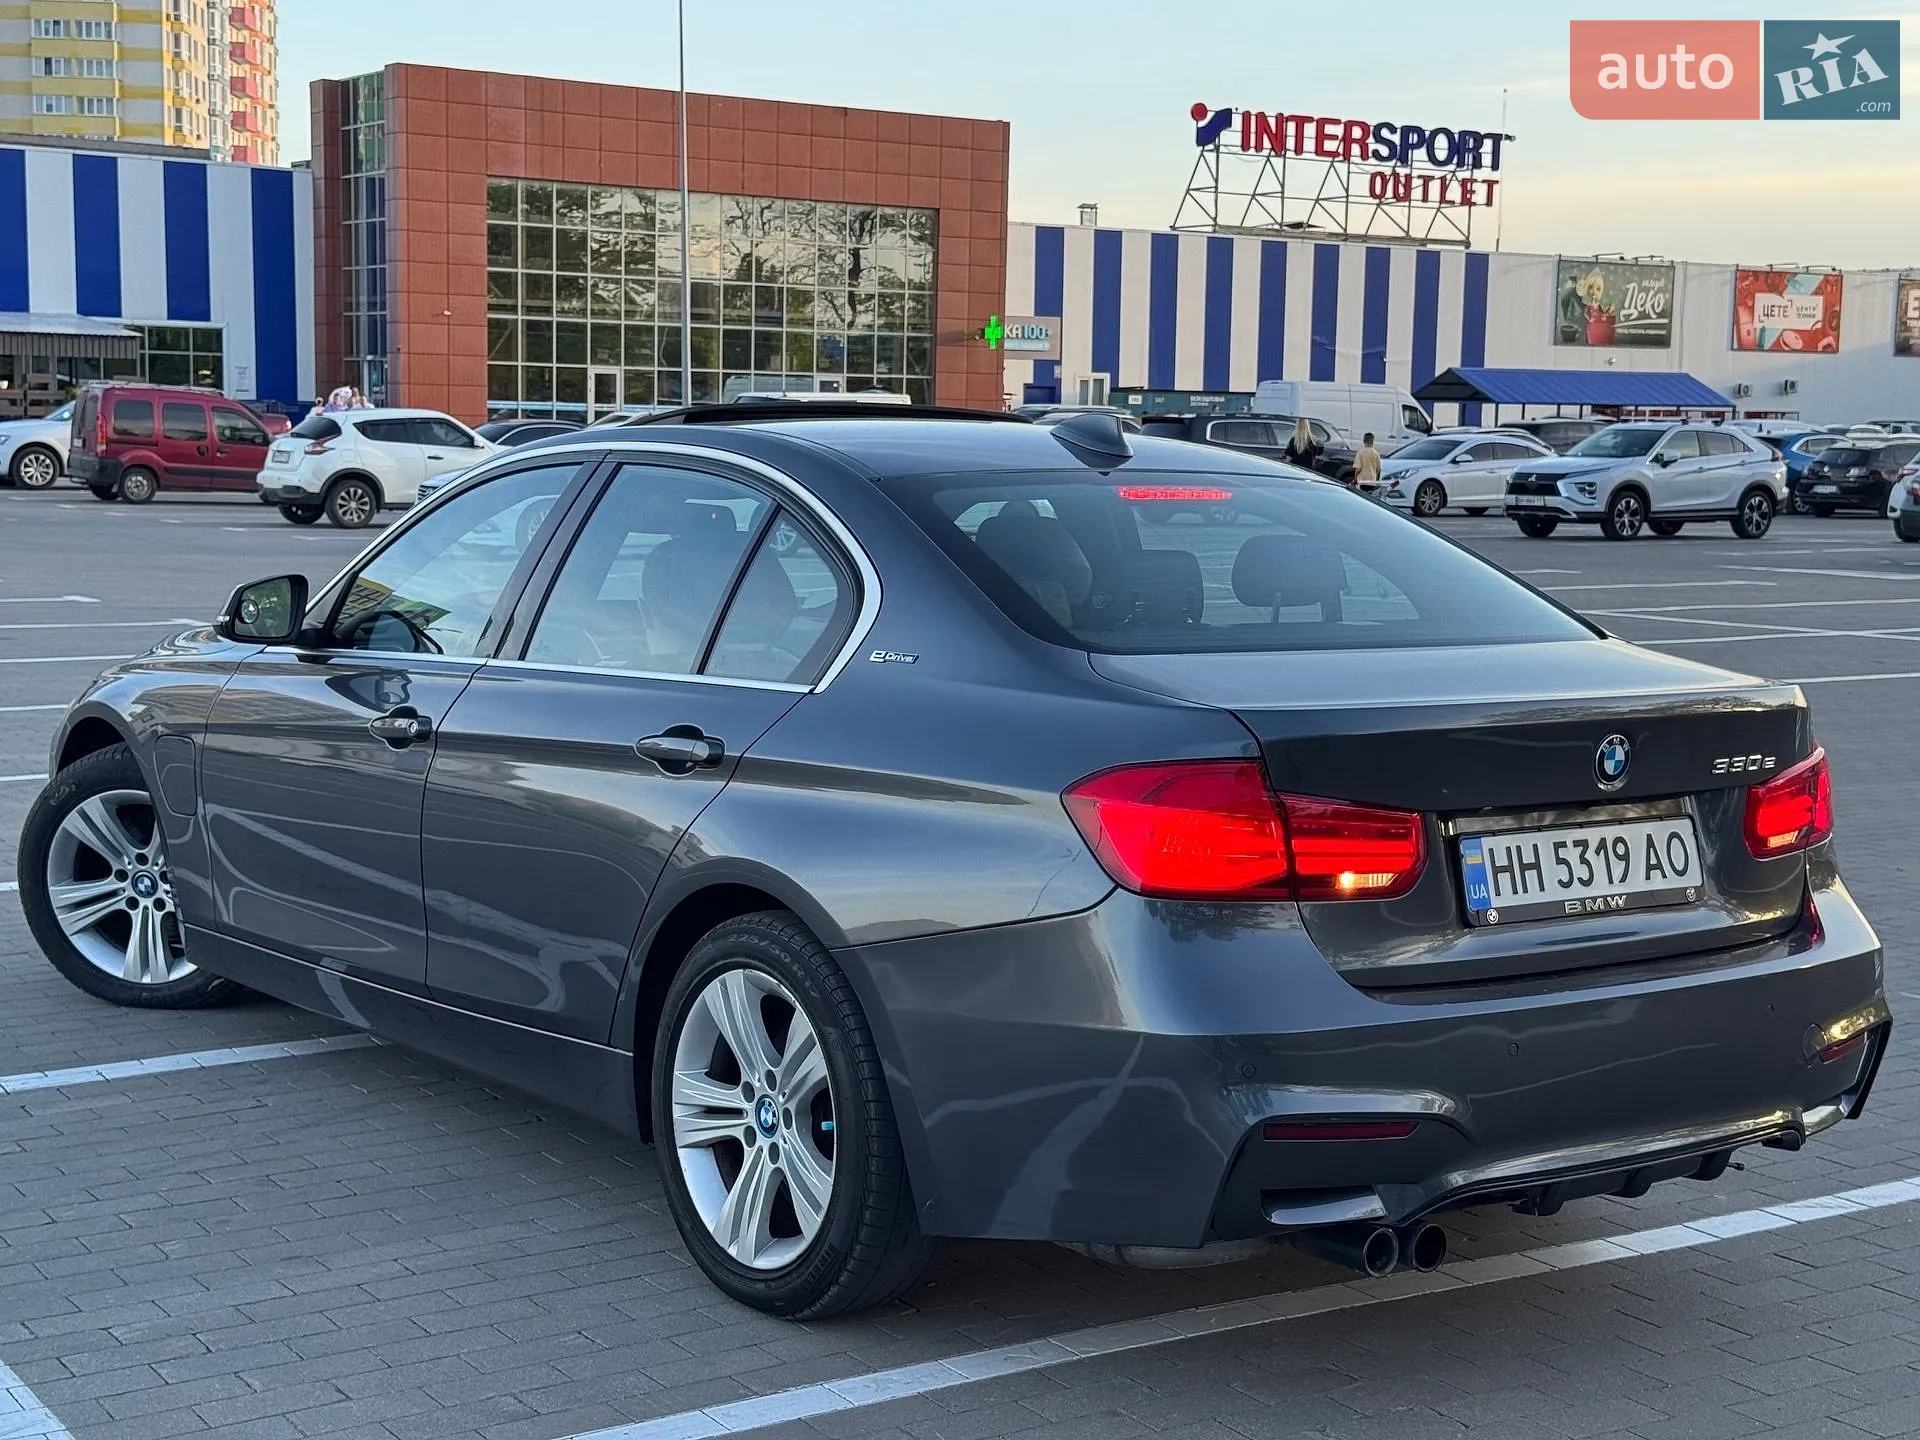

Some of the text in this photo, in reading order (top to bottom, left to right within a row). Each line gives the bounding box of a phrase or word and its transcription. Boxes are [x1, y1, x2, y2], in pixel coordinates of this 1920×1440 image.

[1240, 110, 1509, 172] INTERSPORT
[1368, 171, 1500, 208] OUTLET
[1762, 304, 1789, 320] ЦЕТЕ
[1488, 831, 1690, 897] HH 5319 AO
[1470, 883, 1489, 900] UA
[1564, 895, 1627, 914] BMW
